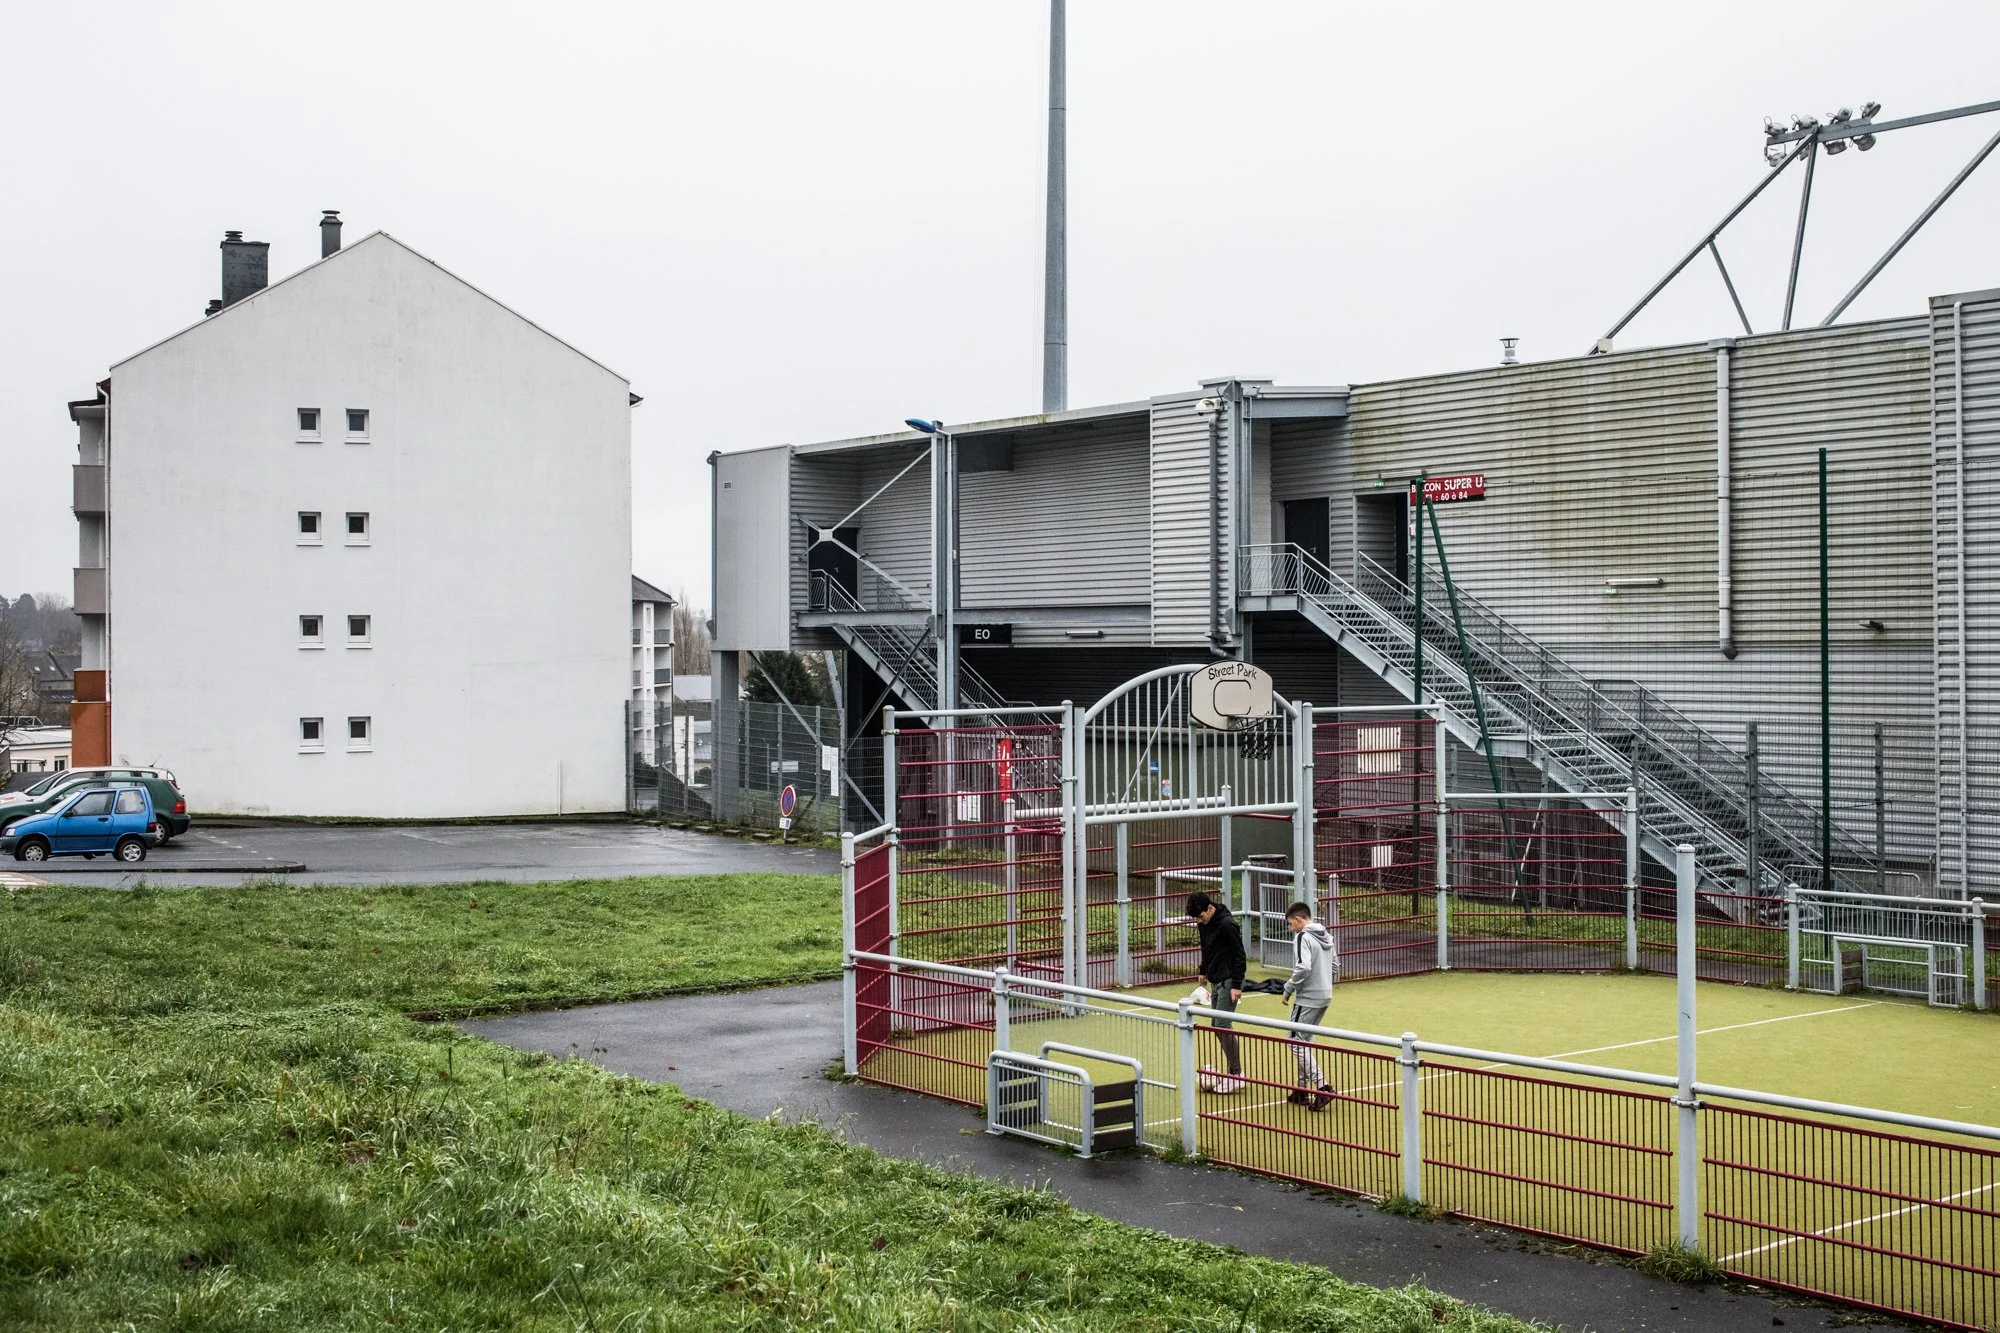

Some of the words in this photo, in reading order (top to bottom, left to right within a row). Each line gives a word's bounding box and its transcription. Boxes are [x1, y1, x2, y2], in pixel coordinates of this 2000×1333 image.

[1411, 483, 1441, 493] BCON
[1444, 478, 1472, 491] SUPER
[1475, 477, 1483, 488] U
[1440, 493, 1450, 501] 60
[1458, 491, 1468, 500] 84
[1208, 664, 1235, 680] Street
[1237, 663, 1257, 680] Park
